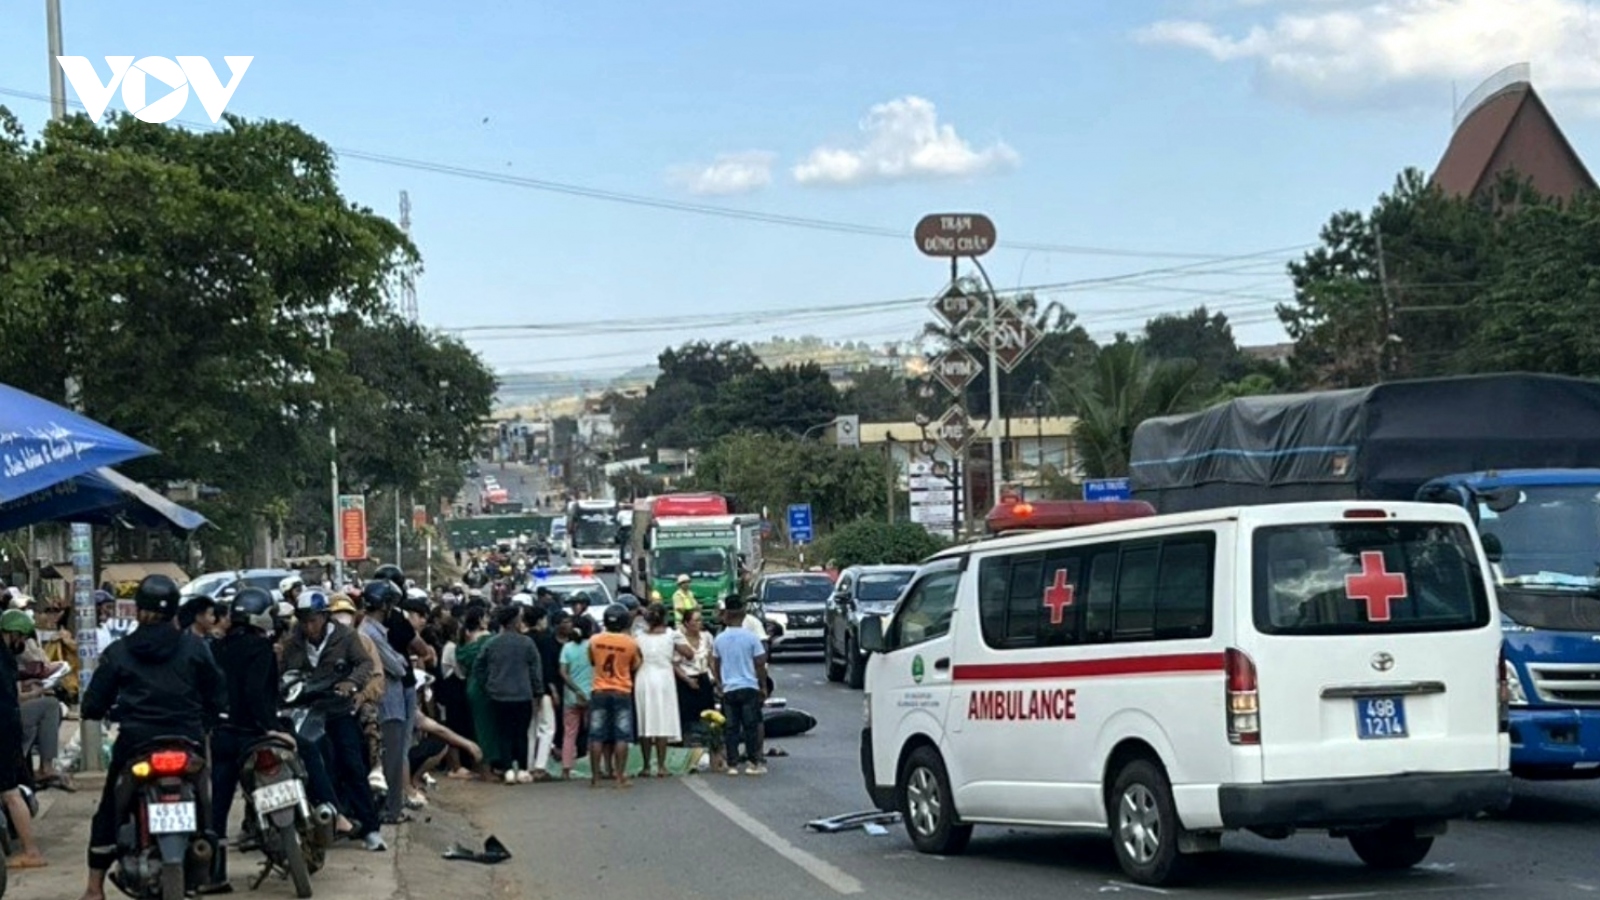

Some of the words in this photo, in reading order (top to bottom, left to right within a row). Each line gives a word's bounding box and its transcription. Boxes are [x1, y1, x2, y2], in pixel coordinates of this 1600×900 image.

[602, 653, 616, 678] 4
[968, 689, 1076, 721] AMBULANCE
[1366, 699, 1396, 717] 49B
[1365, 717, 1403, 735] 1214
